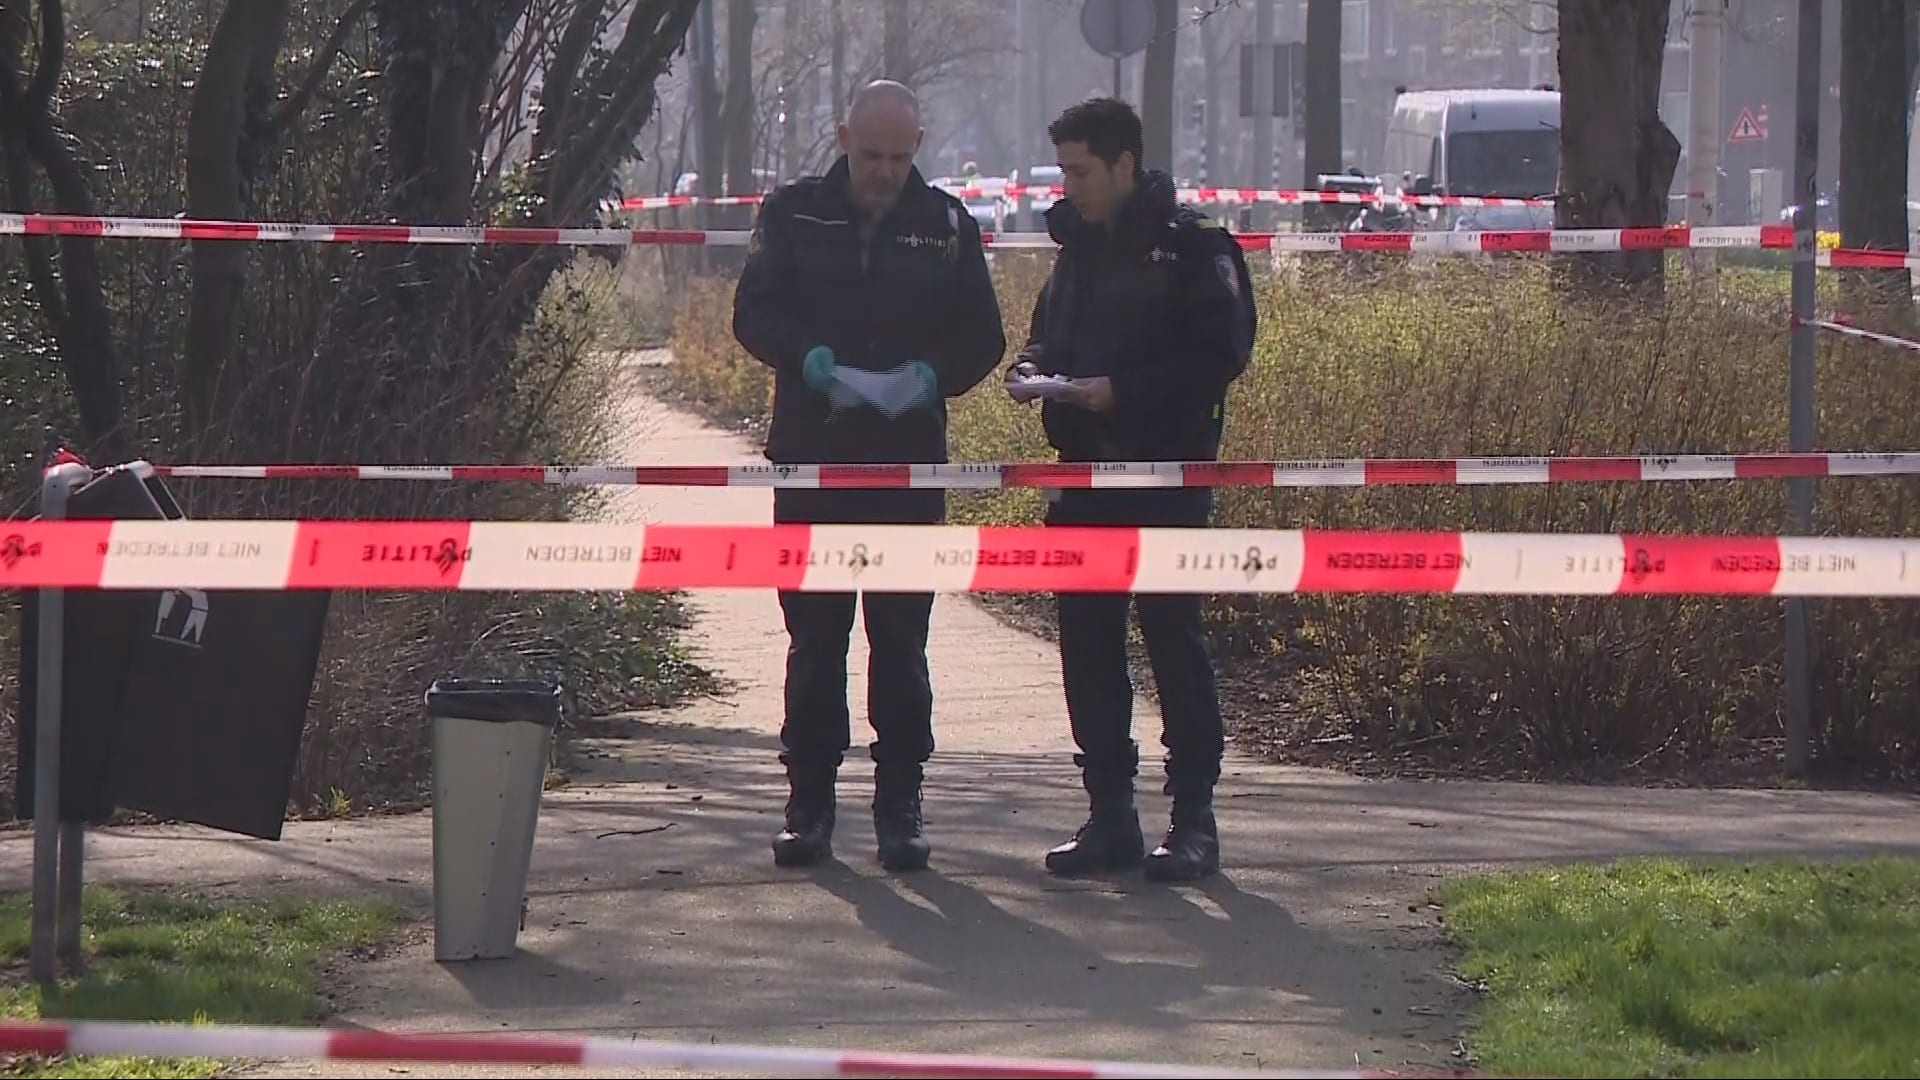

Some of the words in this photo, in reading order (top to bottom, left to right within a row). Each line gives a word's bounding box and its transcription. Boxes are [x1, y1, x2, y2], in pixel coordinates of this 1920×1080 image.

[96, 540, 208, 557] BETREDEN
[217, 541, 261, 557] NIET
[525, 546, 632, 562] BETREDEN
[640, 545, 682, 562] NIET
[934, 549, 1036, 567] BETREDEN
[1041, 549, 1085, 566] NIET
[1327, 552, 1426, 570] BETREDEN
[1430, 553, 1472, 570] NIET
[1711, 555, 1810, 573] BETREDEN
[1817, 555, 1857, 571] NIET
